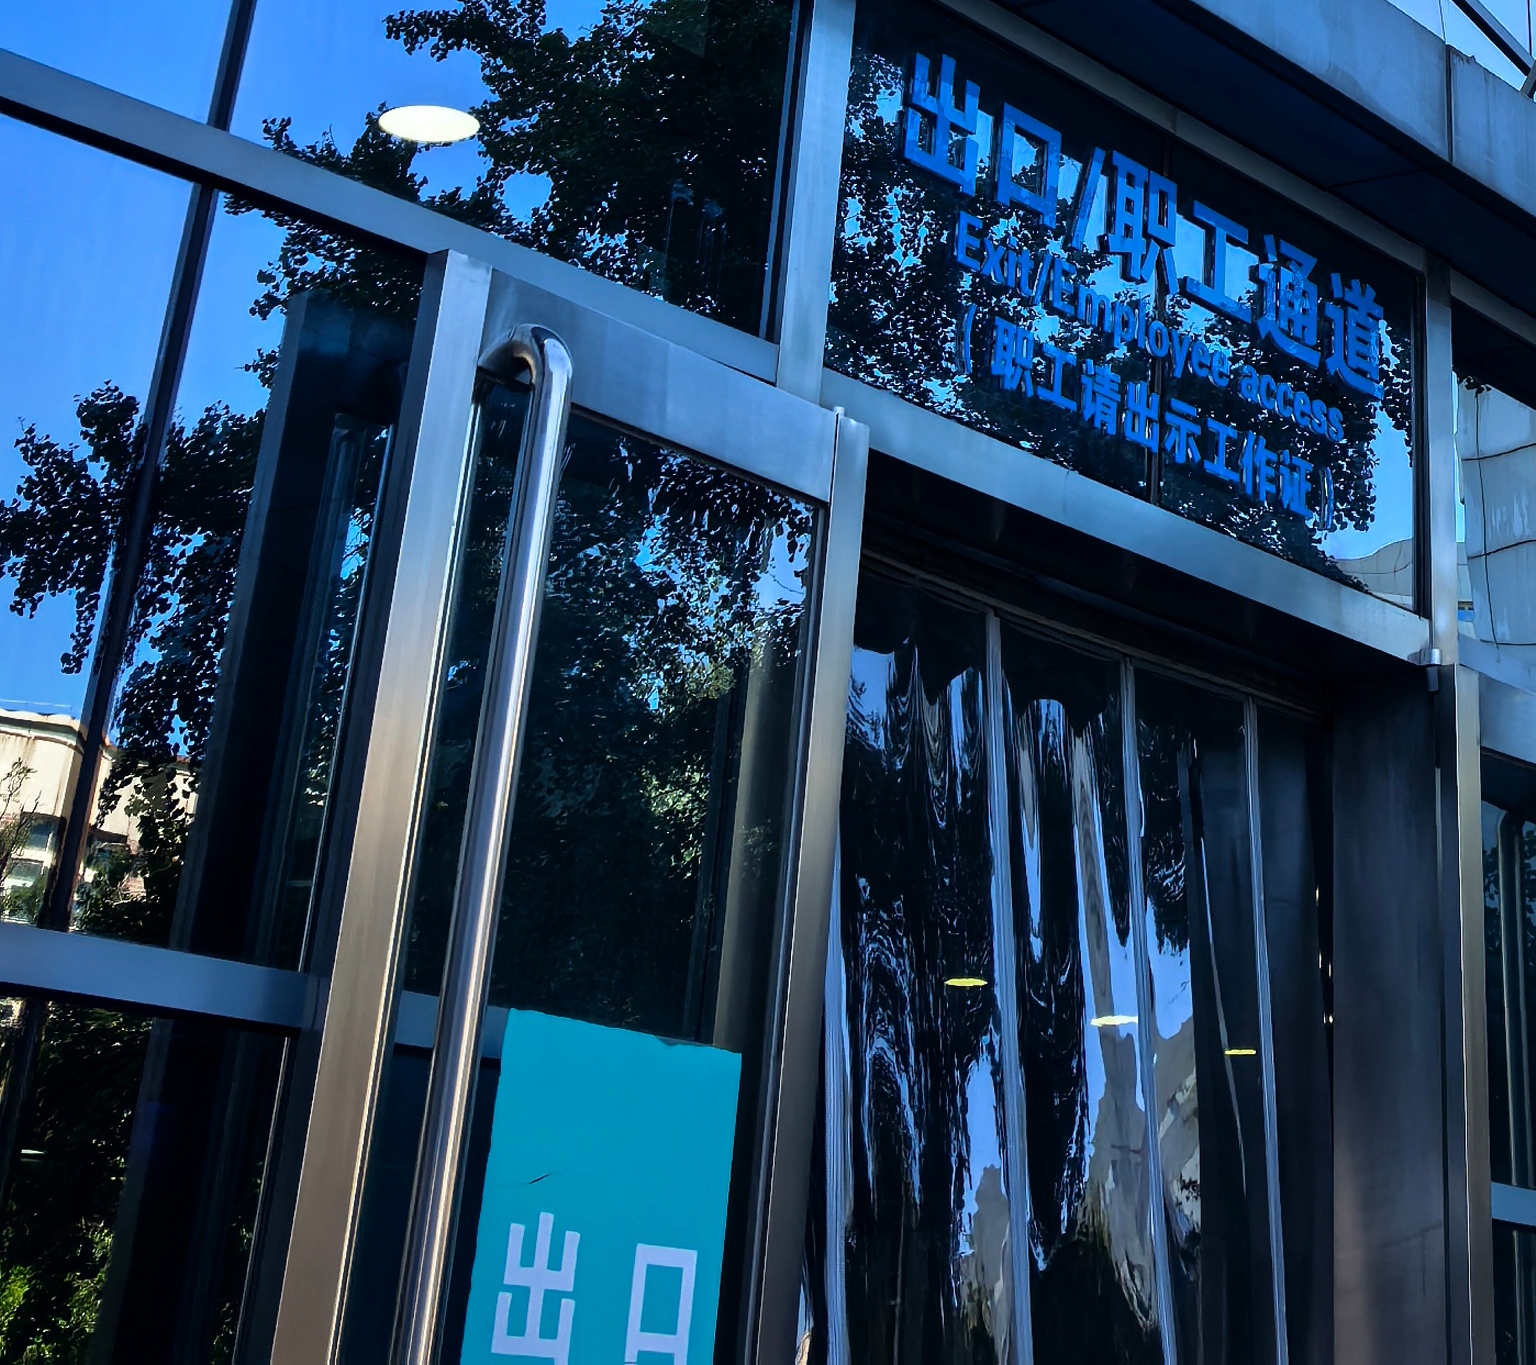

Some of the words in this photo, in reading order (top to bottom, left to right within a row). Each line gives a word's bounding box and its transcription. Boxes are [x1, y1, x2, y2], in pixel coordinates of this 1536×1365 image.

[903, 52, 1385, 400] 出口/职工通道
[953, 211, 1231, 388] Exit/Employee
[1238, 364, 1345, 443] access
[490, 1211, 698, 1365] 出口
